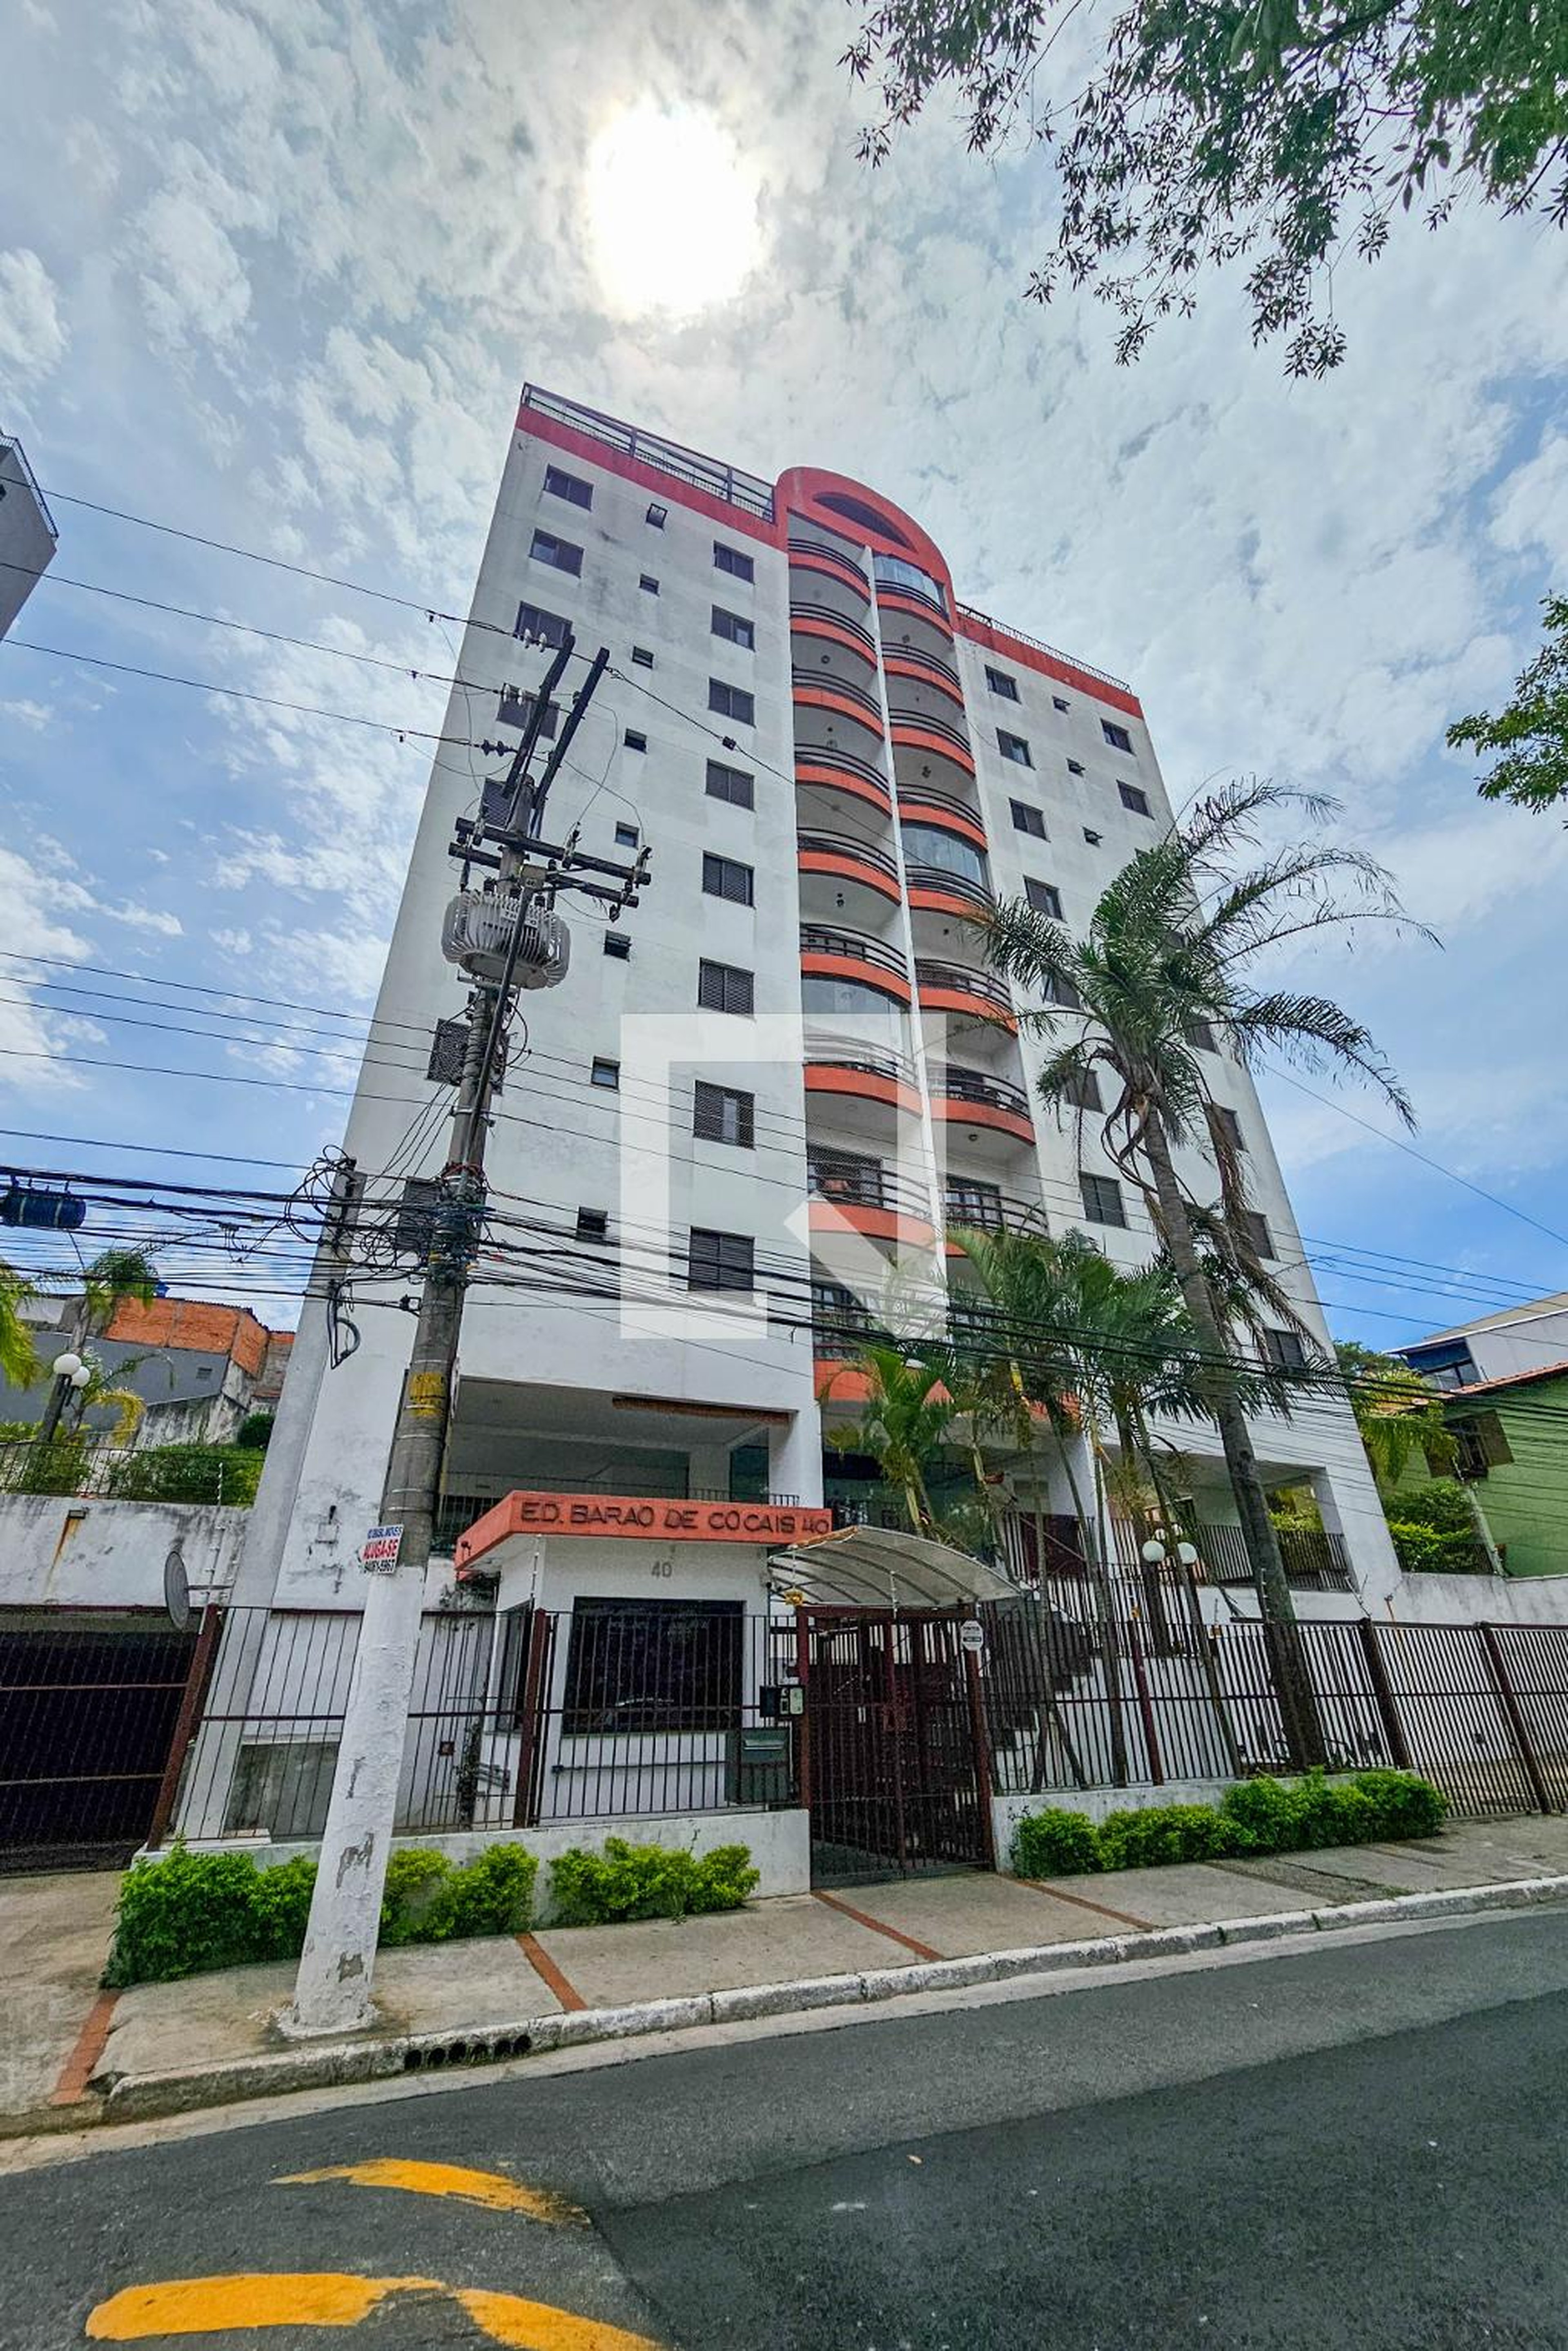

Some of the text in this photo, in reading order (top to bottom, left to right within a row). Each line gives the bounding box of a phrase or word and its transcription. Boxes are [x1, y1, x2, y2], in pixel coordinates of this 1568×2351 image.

[521, 1502, 830, 1535] ED. BARAO DE COCAIS 40
[651, 1561, 672, 1578] 40
